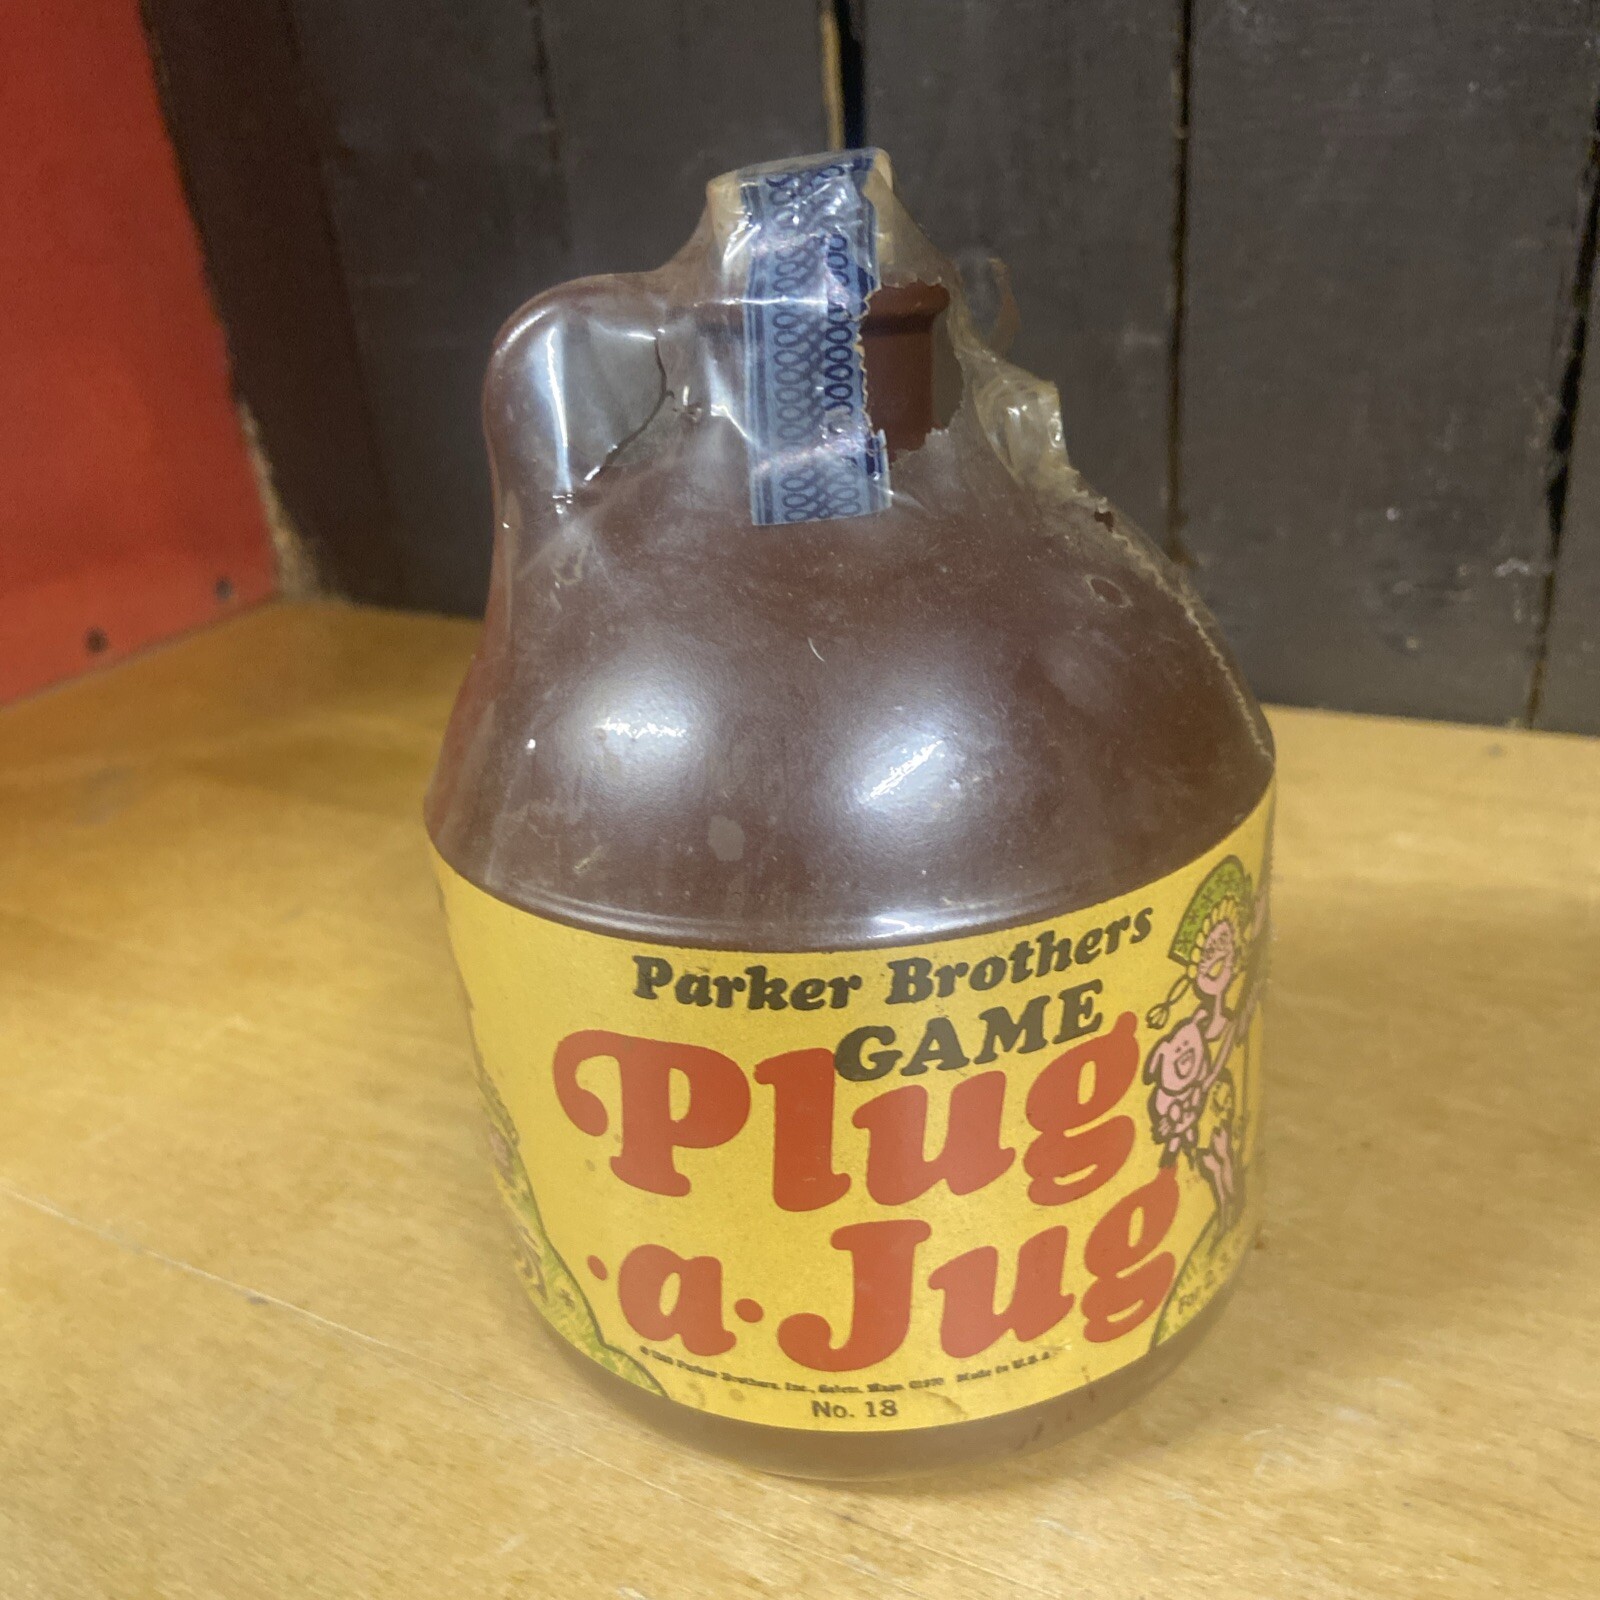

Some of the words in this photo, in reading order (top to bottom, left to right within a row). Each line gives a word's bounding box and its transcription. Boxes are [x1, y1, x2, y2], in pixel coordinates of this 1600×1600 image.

[632, 955, 862, 1012] Parker
[885, 907, 1154, 1005] Brothers
[832, 979, 1105, 1082] GAME
[552, 1011, 1140, 1213] Plug
[777, 1168, 1180, 1373] Jug
[811, 1399, 856, 1419] No.
[865, 1398, 898, 1418] 18
